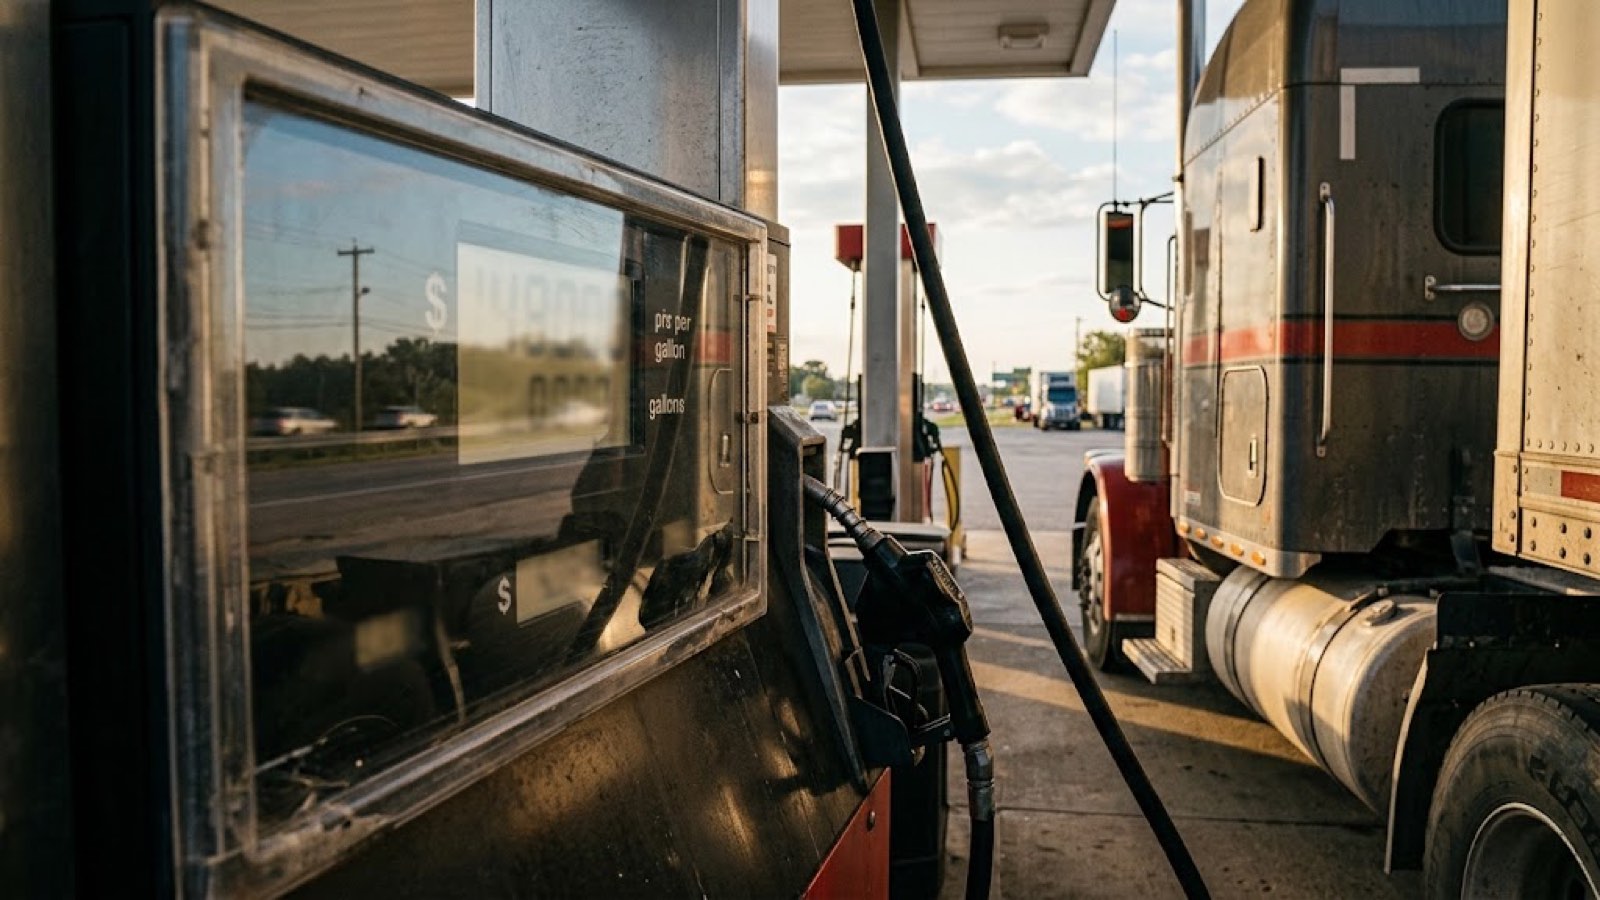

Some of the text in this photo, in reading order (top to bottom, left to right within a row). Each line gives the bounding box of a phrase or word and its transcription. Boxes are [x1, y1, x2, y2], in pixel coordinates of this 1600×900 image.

[425, 271, 447, 334] $
[674, 315, 691, 335] per
[655, 338, 685, 363] gallon
[497, 576, 512, 615] $
